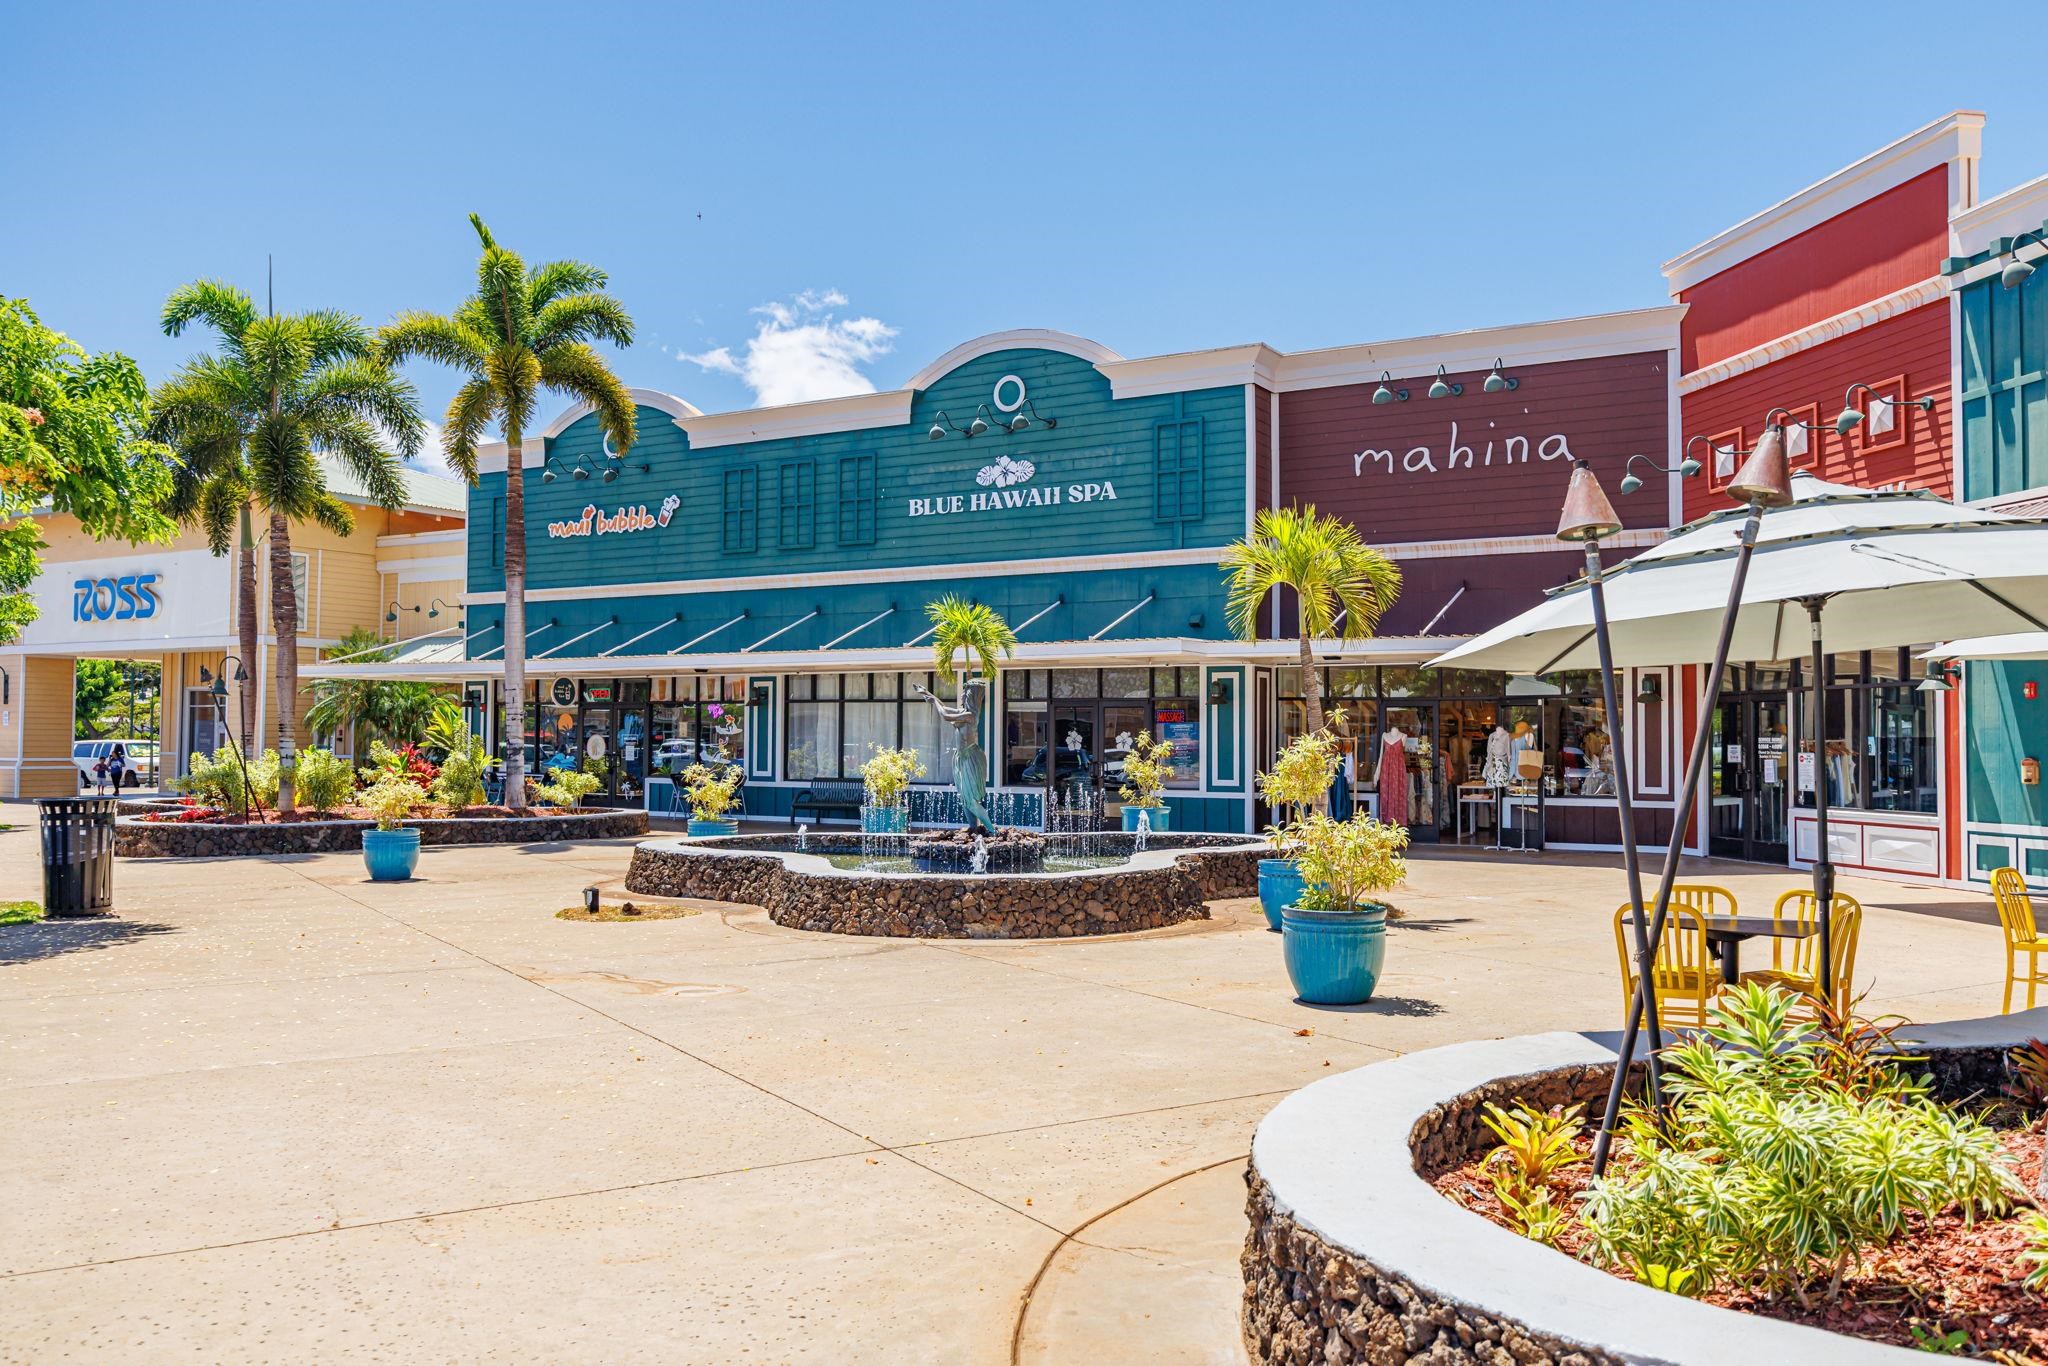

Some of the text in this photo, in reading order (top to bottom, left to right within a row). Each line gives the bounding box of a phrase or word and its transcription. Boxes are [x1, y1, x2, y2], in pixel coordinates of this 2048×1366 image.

[1353, 421, 1575, 477] mahina
[908, 481, 1117, 516] BLUE HAWAII SPA
[548, 504, 657, 538] maui bubble
[73, 574, 157, 622] ROSS
[591, 689, 609, 699] OPEN
